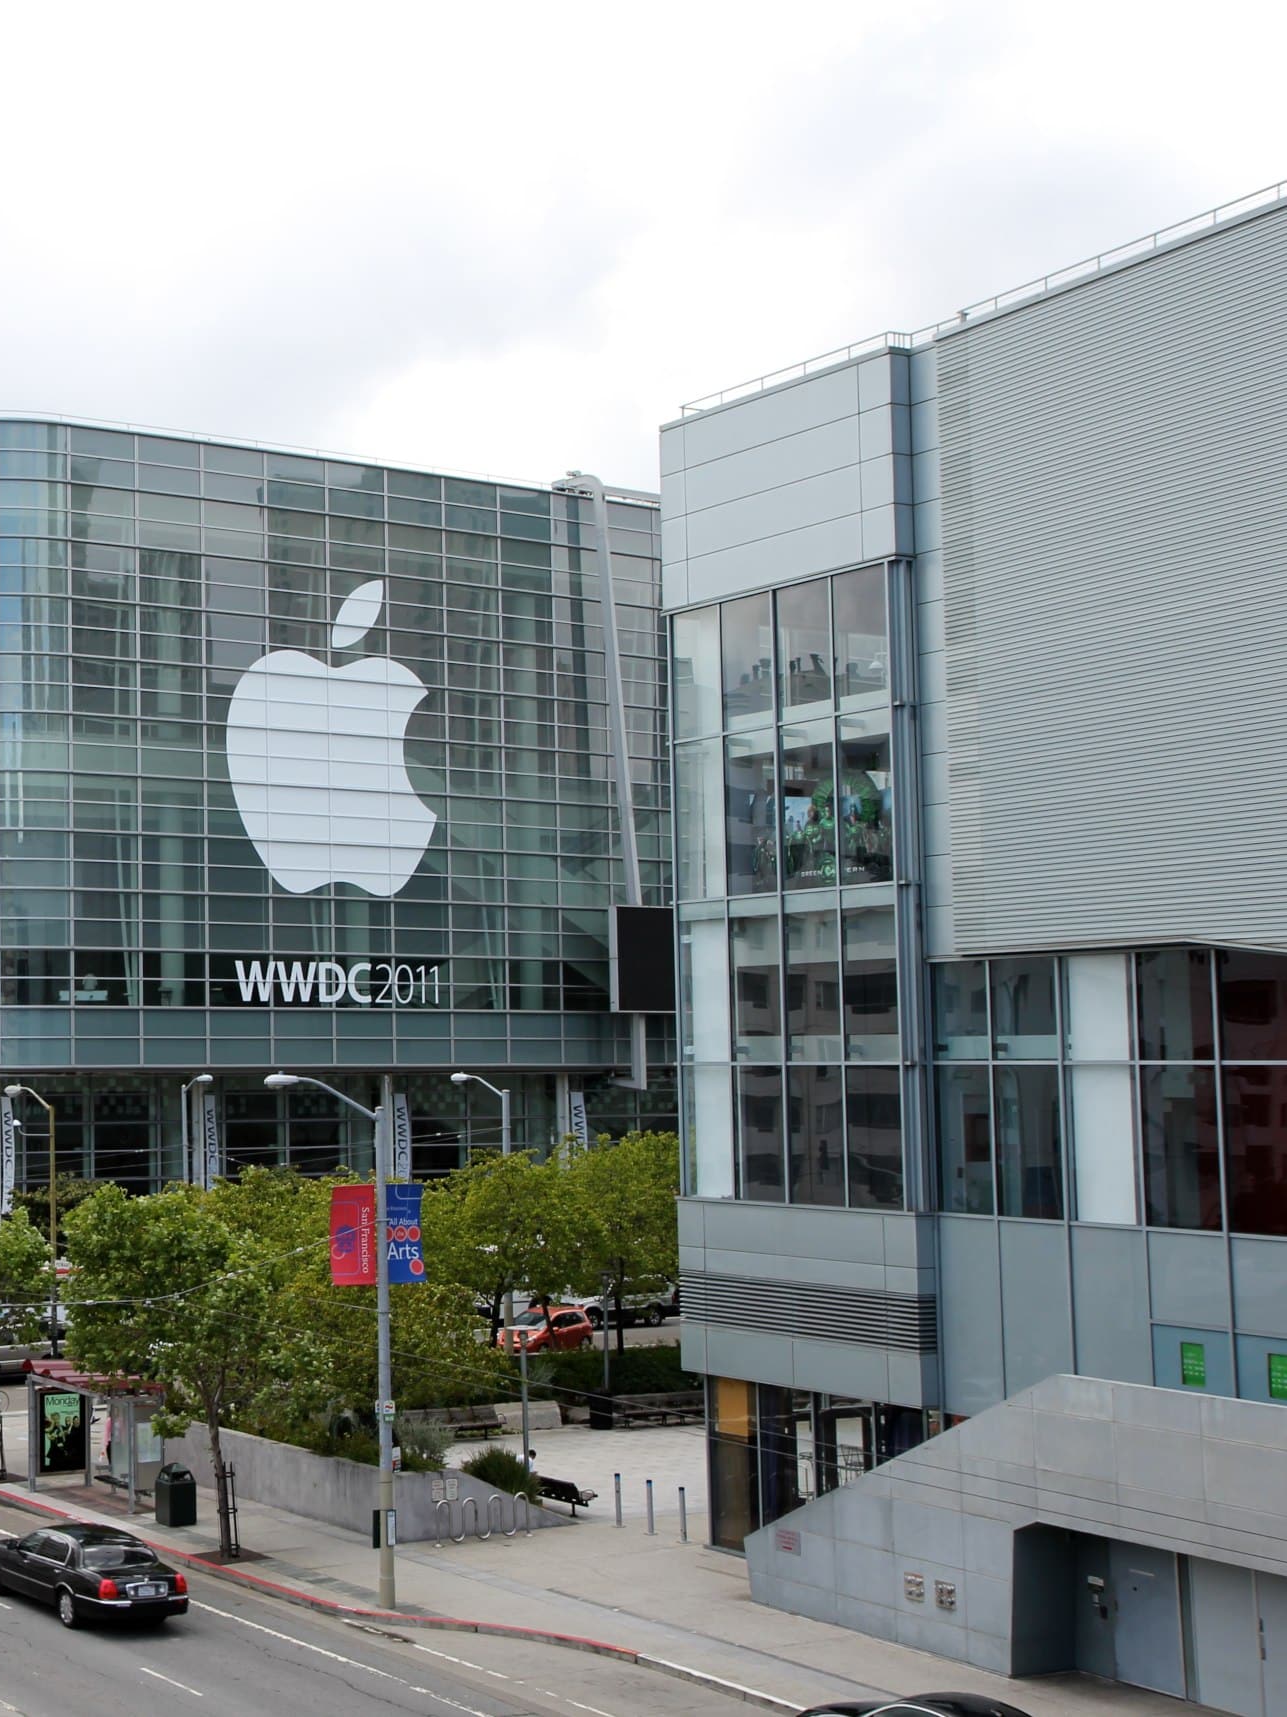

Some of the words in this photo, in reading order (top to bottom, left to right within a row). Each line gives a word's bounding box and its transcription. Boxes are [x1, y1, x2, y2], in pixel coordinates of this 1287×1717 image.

[234, 960, 439, 1004] WWDC2011
[396, 1106, 409, 1179] WWDC20
[399, 1218, 418, 1226] About
[361, 1228, 370, 1273] Francisco
[387, 1242, 419, 1260] Arts
